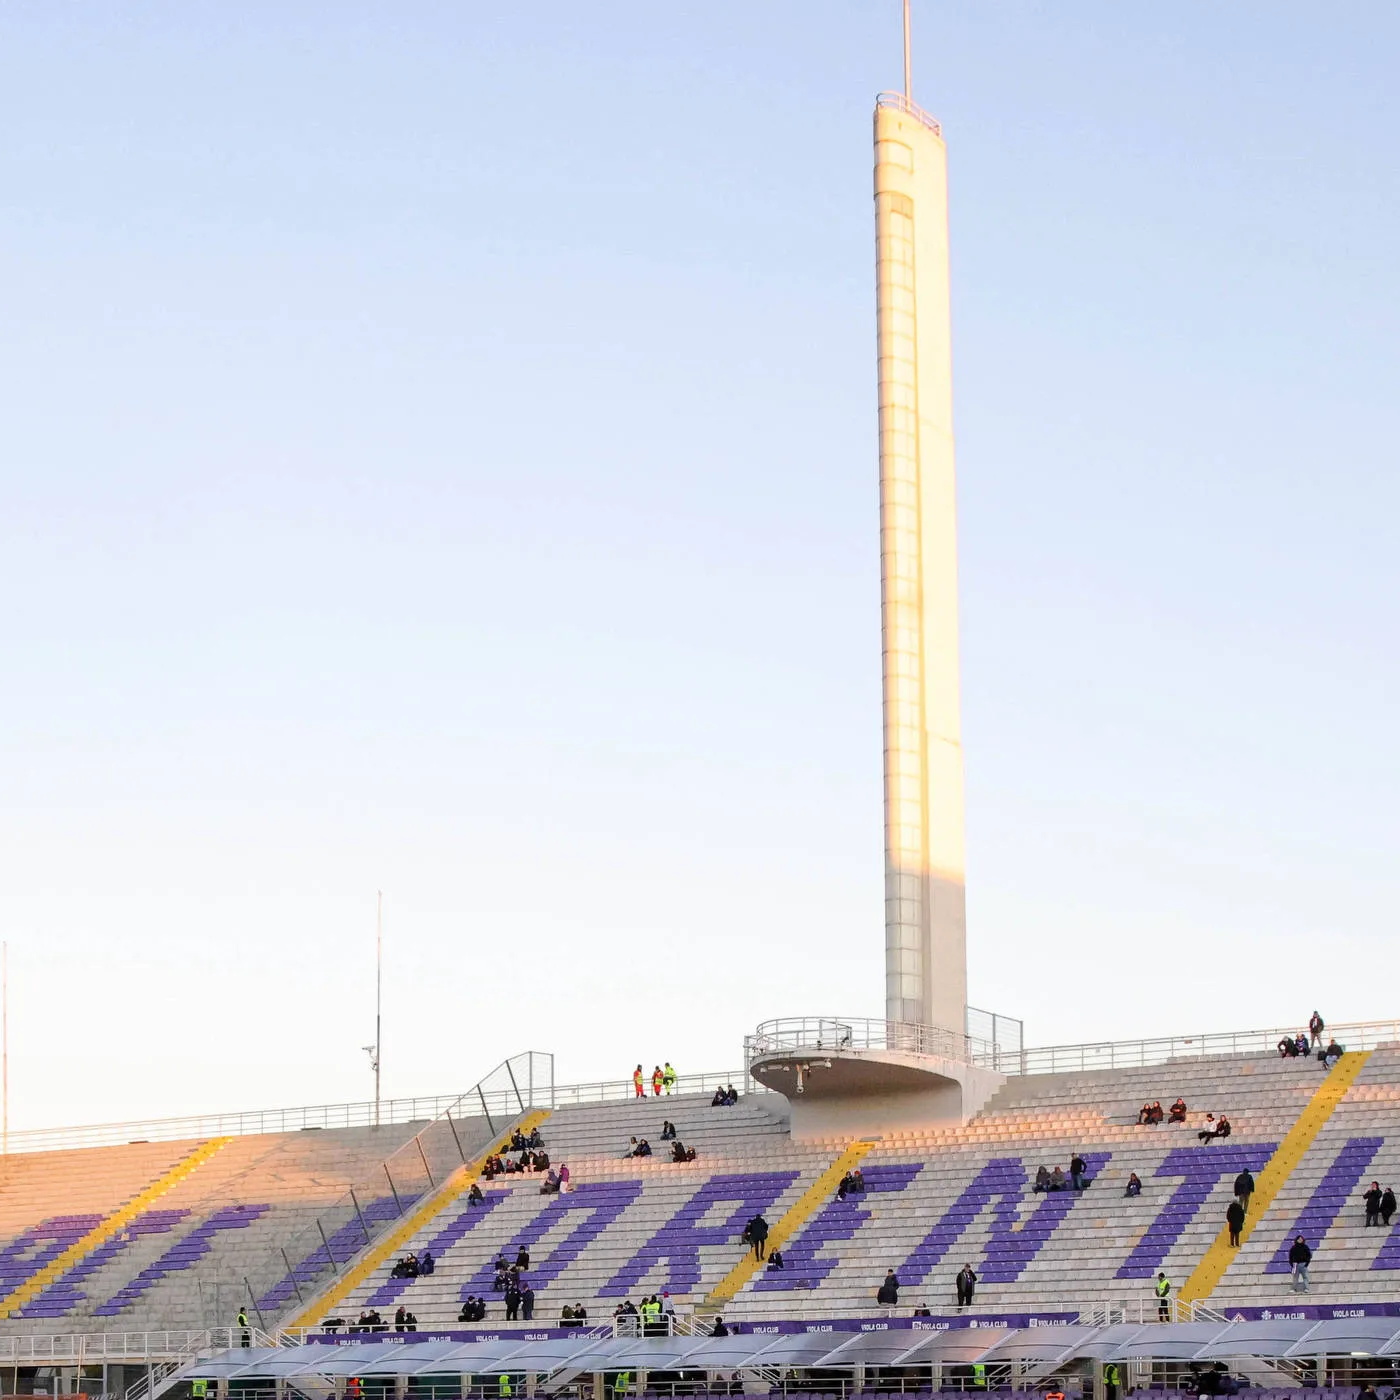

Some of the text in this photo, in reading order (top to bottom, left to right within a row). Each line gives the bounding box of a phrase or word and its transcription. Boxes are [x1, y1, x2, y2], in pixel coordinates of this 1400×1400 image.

[1274, 1312, 1290, 1320] VIOLA
[1332, 1309, 1364, 1318] VIOLA CLUB
